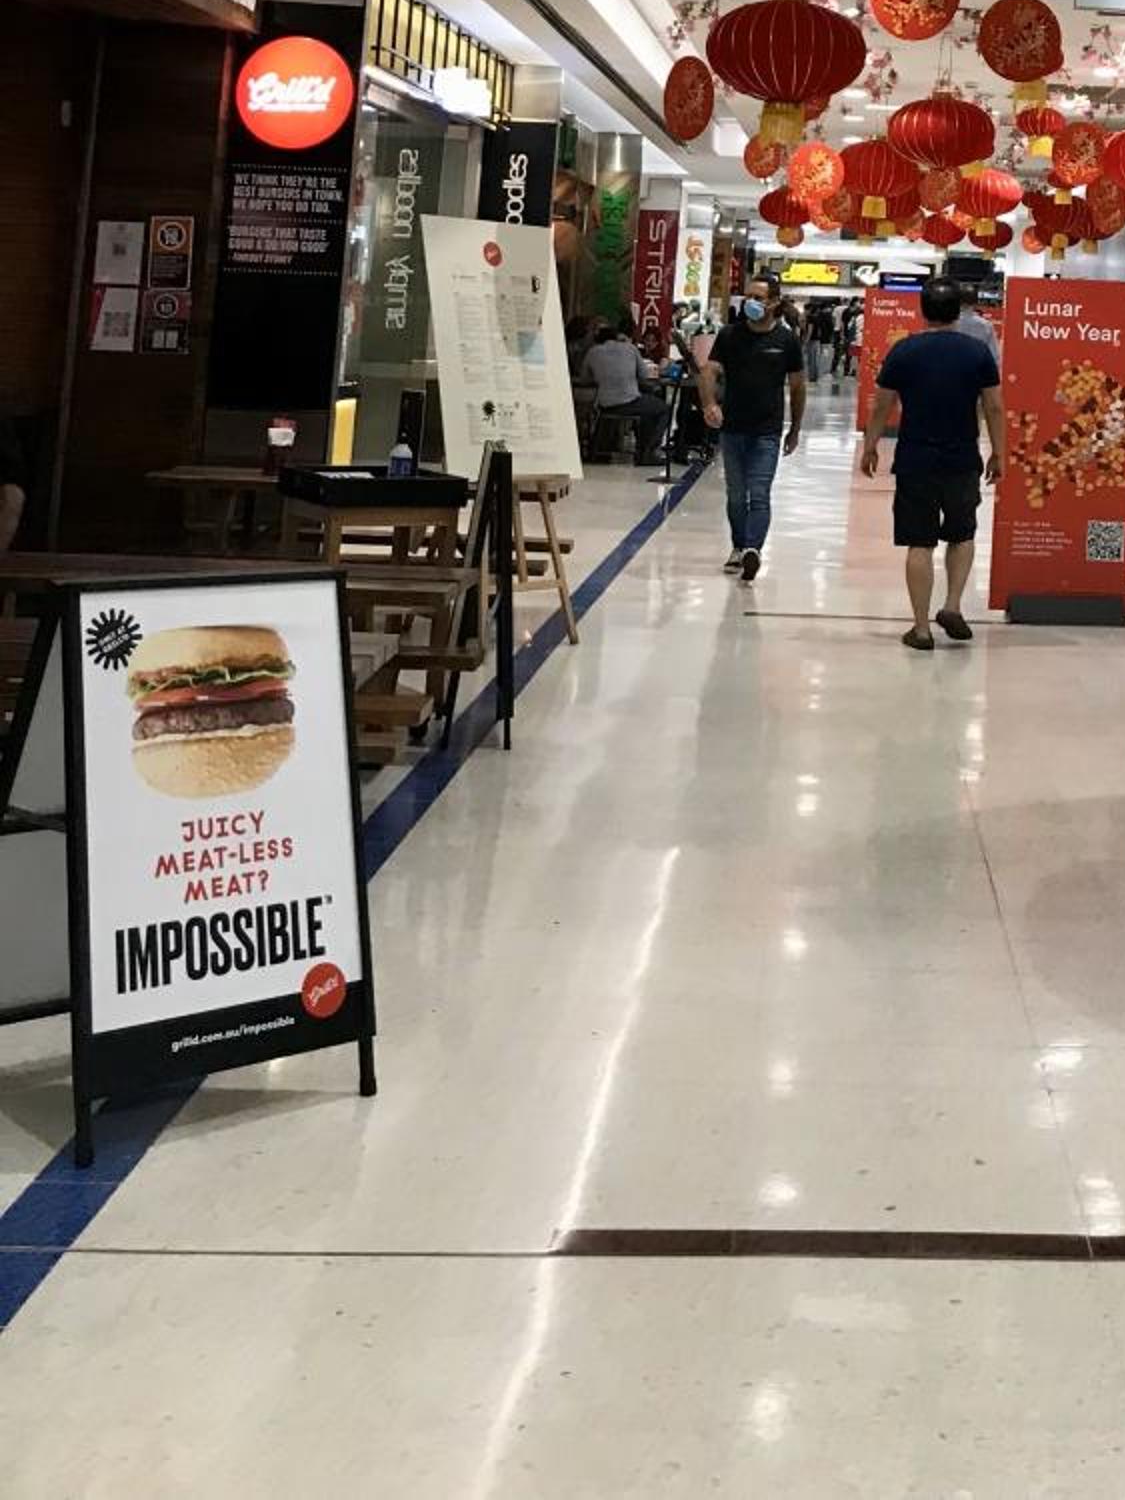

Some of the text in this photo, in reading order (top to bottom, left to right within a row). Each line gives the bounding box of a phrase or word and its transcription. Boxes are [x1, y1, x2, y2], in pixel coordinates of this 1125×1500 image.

[502, 153, 529, 226] oodles
[1024, 296, 1083, 317] Lunar
[1023, 320, 1121, 342] New Year
[181, 810, 265, 843] JUICY
[155, 836, 294, 879] MEAT-LESS
[184, 869, 270, 904] MEAT?
